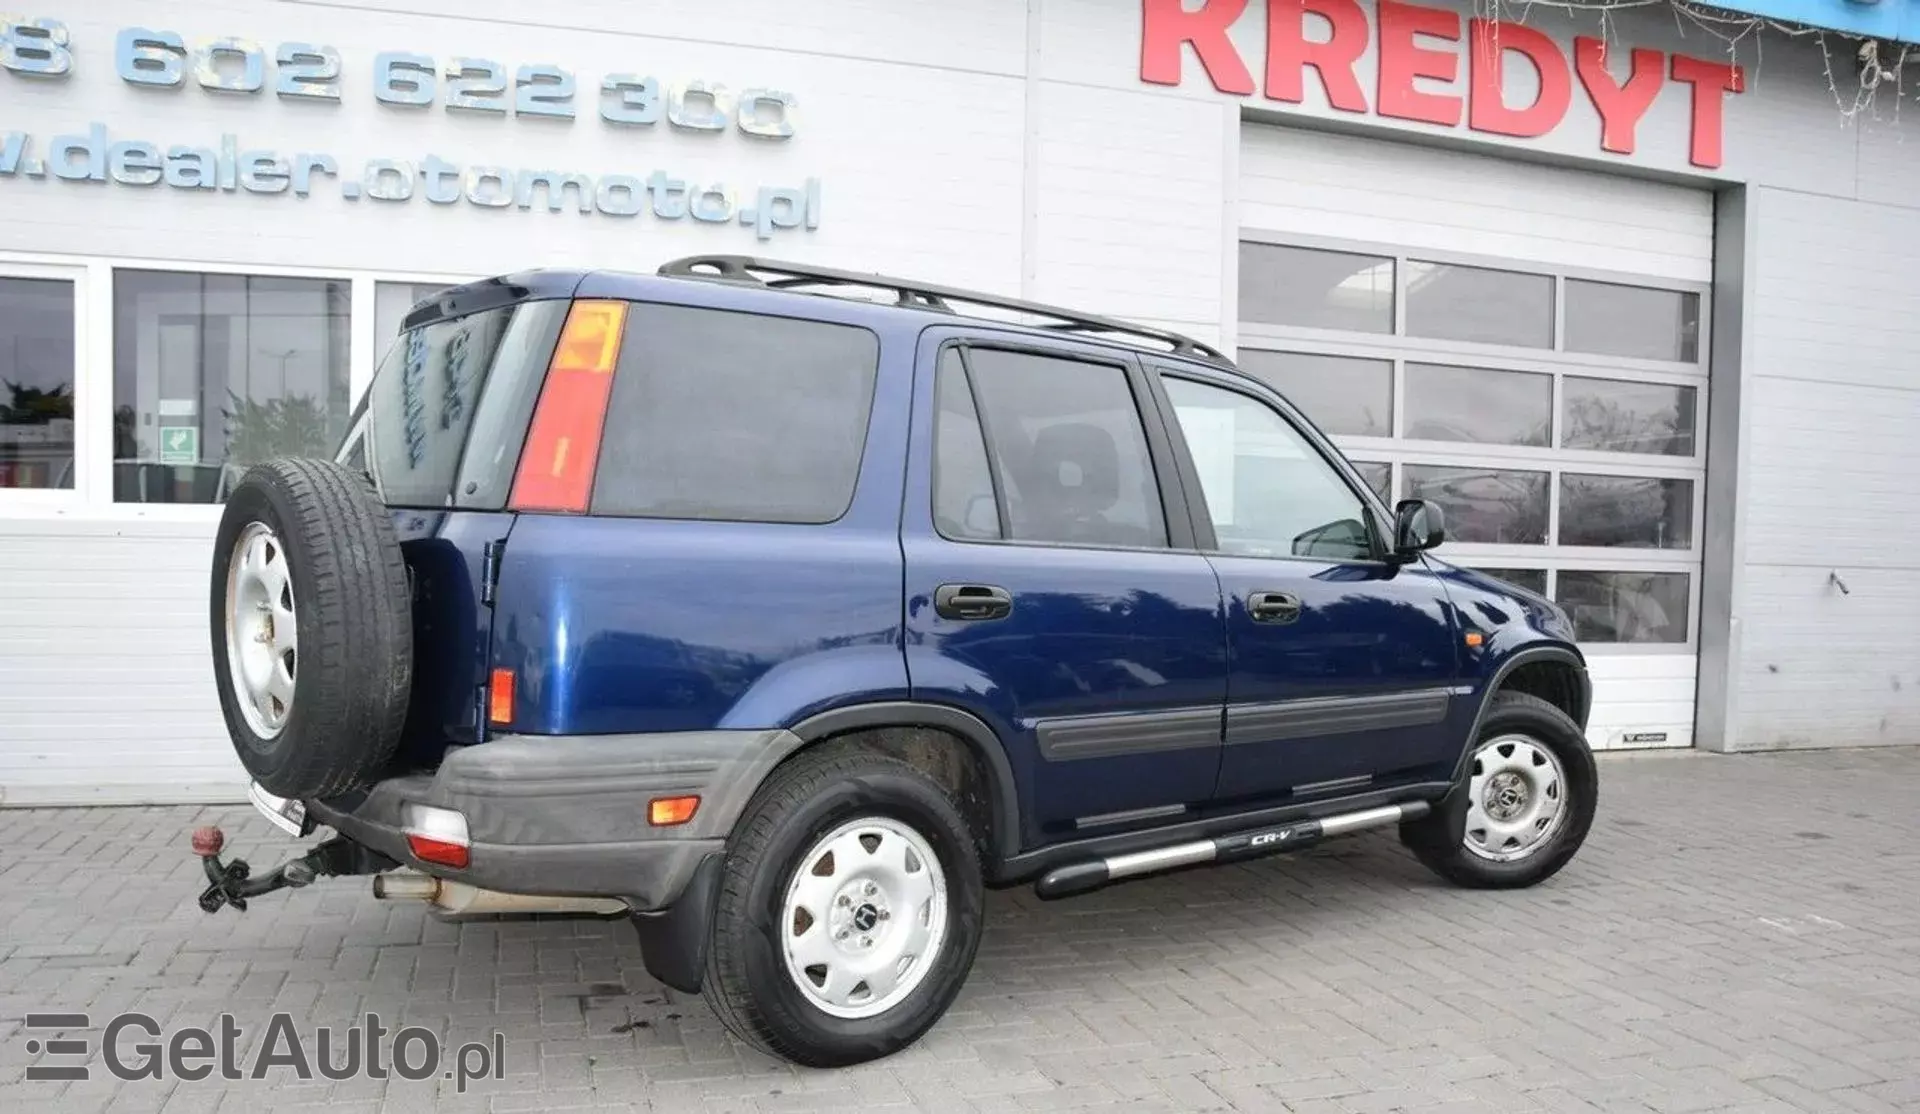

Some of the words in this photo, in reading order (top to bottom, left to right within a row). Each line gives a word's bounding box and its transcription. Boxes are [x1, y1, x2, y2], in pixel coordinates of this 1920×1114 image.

[115, 26, 343, 104] 602
[373, 51, 577, 121] 622
[599, 72, 799, 139] 300
[1140, 0, 1745, 169] KREDYT
[1251, 829, 1291, 846] CR-V
